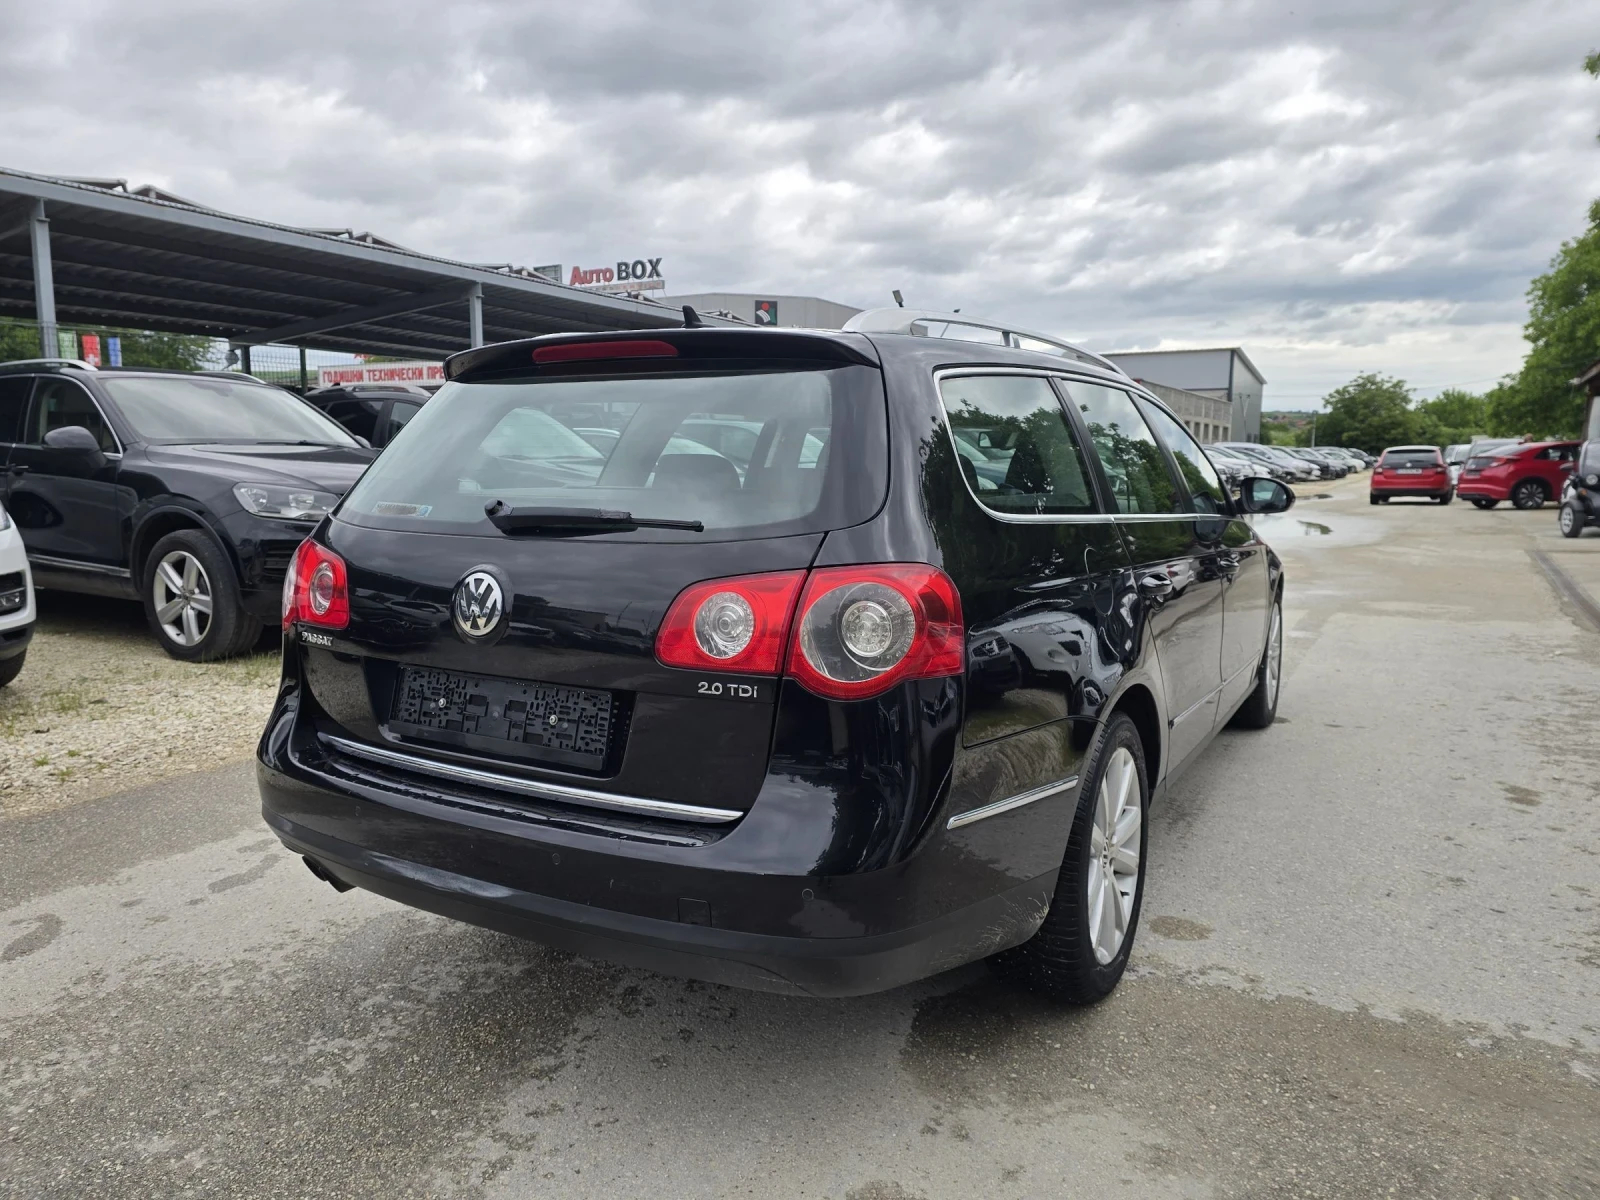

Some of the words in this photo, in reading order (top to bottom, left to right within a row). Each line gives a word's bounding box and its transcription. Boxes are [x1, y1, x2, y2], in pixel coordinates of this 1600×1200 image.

[617, 258, 662, 281] BOX
[323, 369, 364, 383] ГОДИШНИ
[366, 366, 423, 381] ТЕХНИЧЕСКИ
[427, 365, 444, 379] ПРЕ
[301, 631, 333, 646] PASSAT
